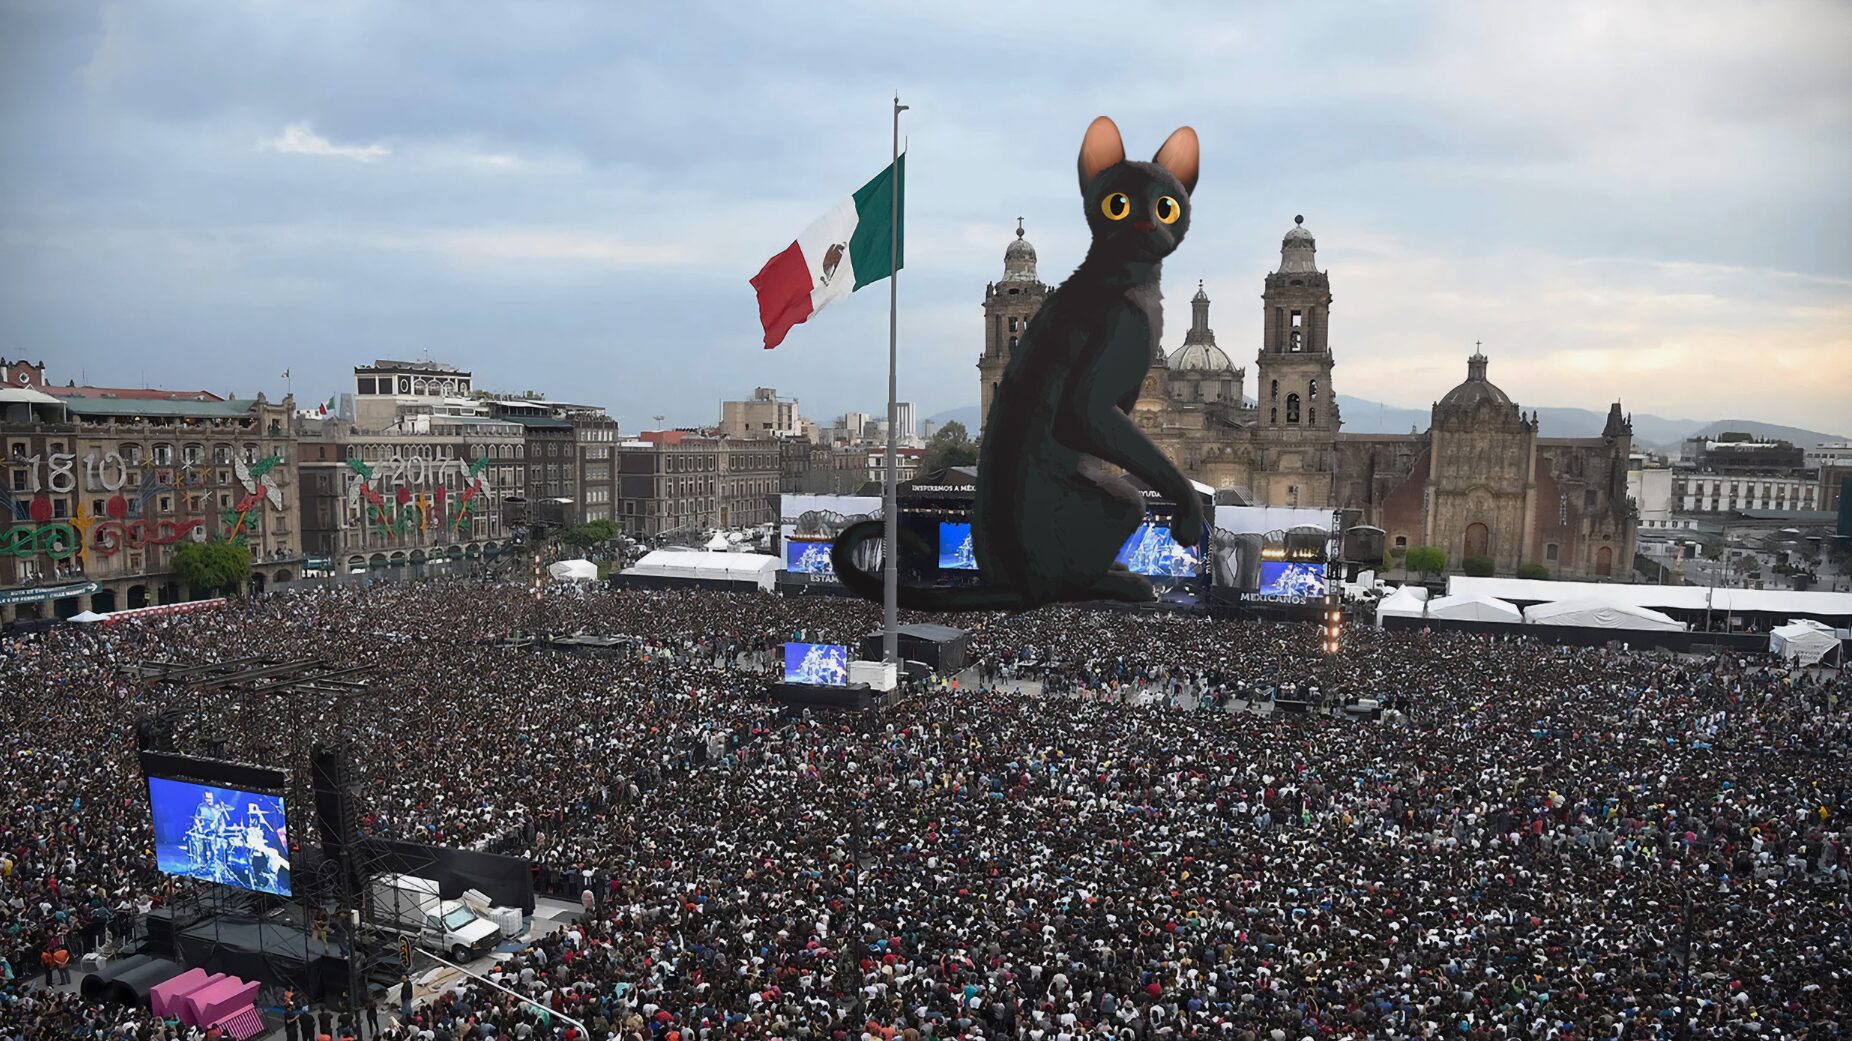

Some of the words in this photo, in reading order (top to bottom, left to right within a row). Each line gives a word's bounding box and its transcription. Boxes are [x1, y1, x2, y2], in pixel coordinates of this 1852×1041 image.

[28, 452, 127, 493] 1810
[389, 455, 451, 487] 2017
[960, 483, 977, 492] MÉX
[1138, 490, 1162, 498] YUDA
[810, 574, 840, 584] ESTAM
[1240, 592, 1307, 605] MEXICANOS
